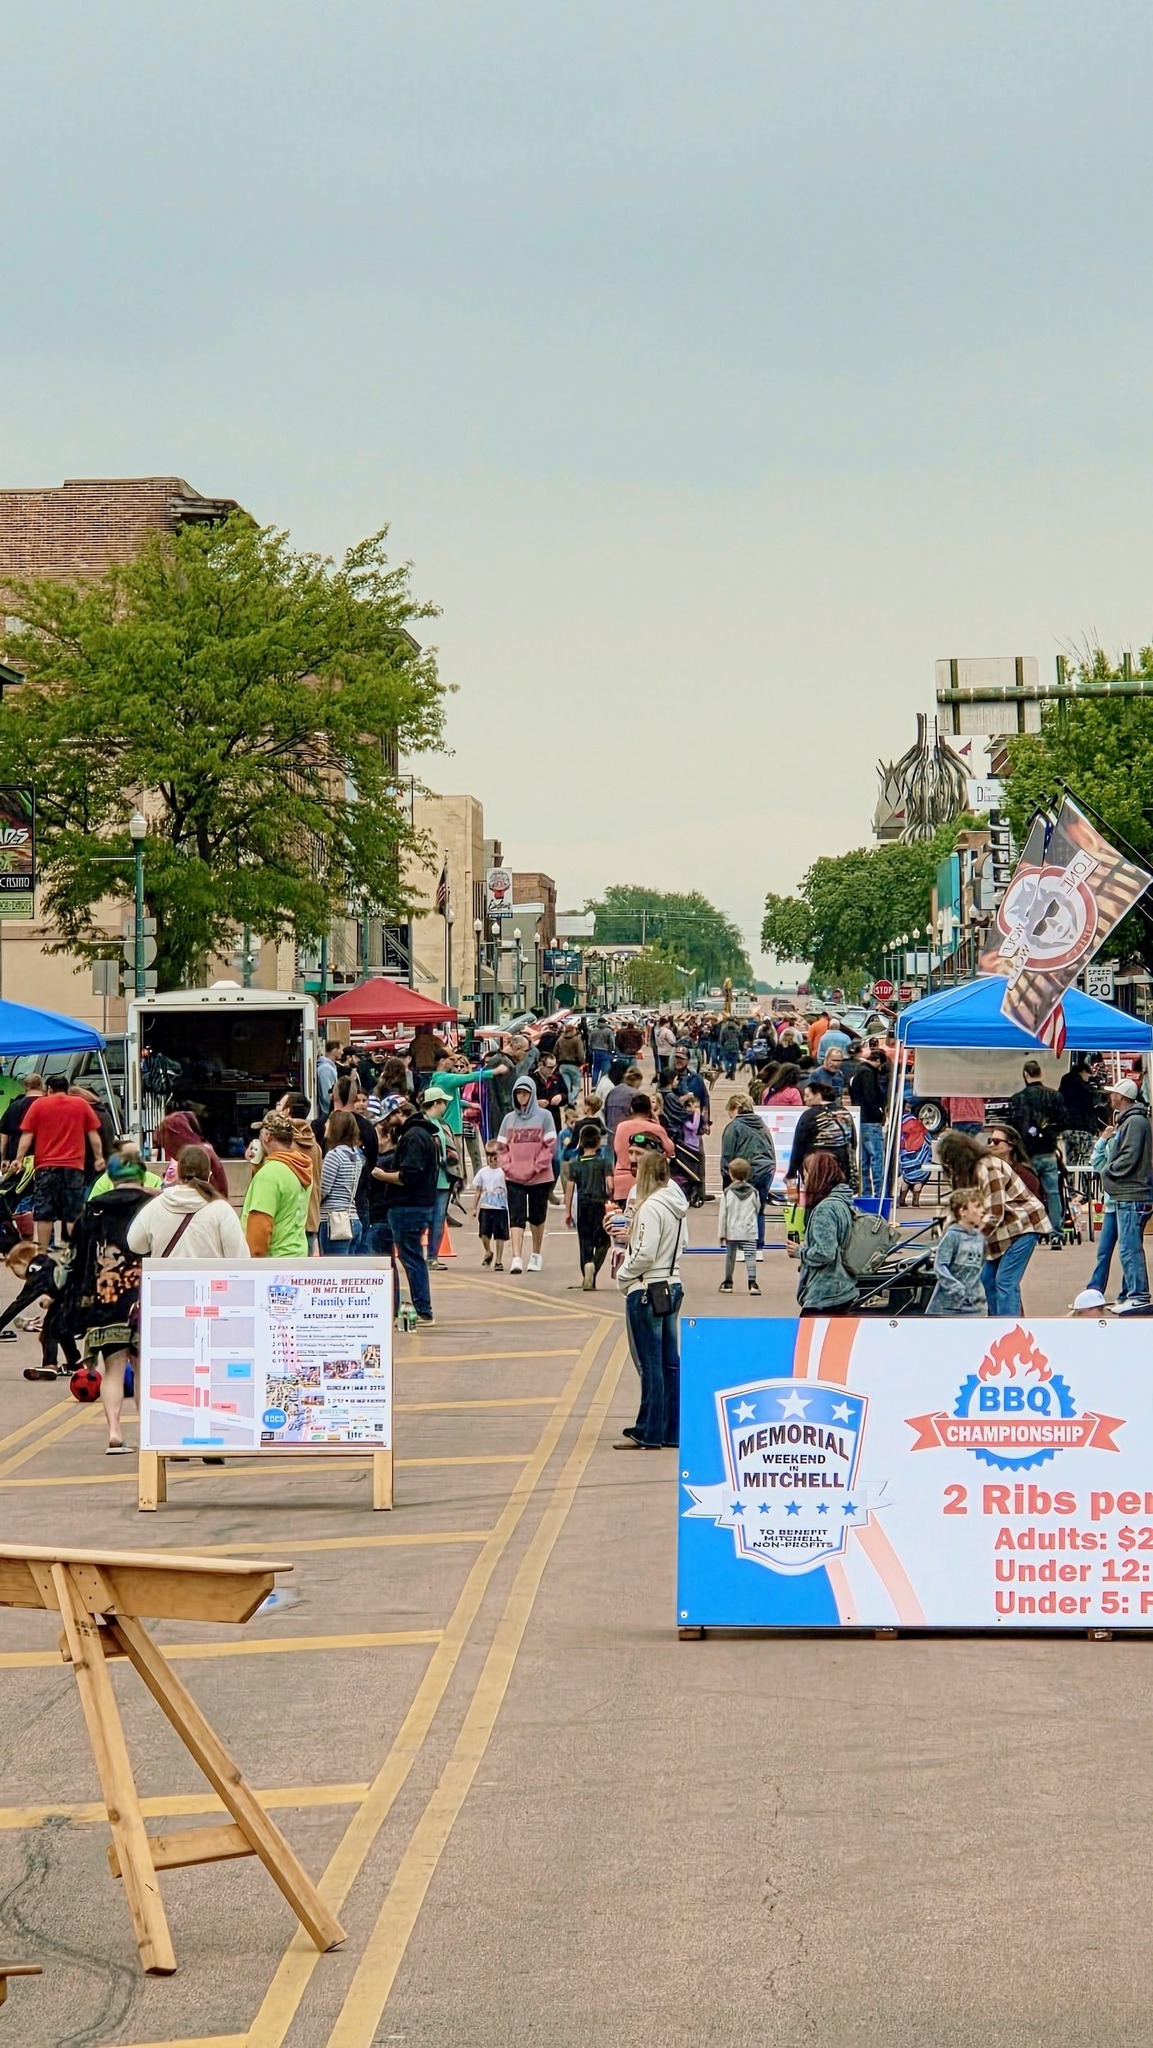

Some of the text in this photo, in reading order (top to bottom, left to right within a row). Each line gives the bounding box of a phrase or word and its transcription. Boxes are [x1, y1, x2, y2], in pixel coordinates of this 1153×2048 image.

[875, 986, 893, 994] STOP
[1088, 984, 1111, 996] 20
[291, 1278, 384, 1286] MEMORIAL WEEKEND
[312, 1286, 366, 1294] IN MITCHELL
[311, 1296, 371, 1308] Family Fun!
[979, 1386, 1052, 1417] BBQ
[946, 1425, 1084, 1442] CHAMPIONSHIP
[738, 1424, 849, 1461] MEMORIAL
[762, 1454, 826, 1464] WEEKEND
[743, 1472, 845, 1488] MITCHELL
[943, 1484, 968, 1515] 2
[983, 1484, 1077, 1515] Ribs
[994, 1527, 1107, 1550] Adults:
[995, 1558, 1150, 1582] Under 12:
[995, 1590, 1091, 1614] Under
[1101, 1590, 1129, 1614] 5:
